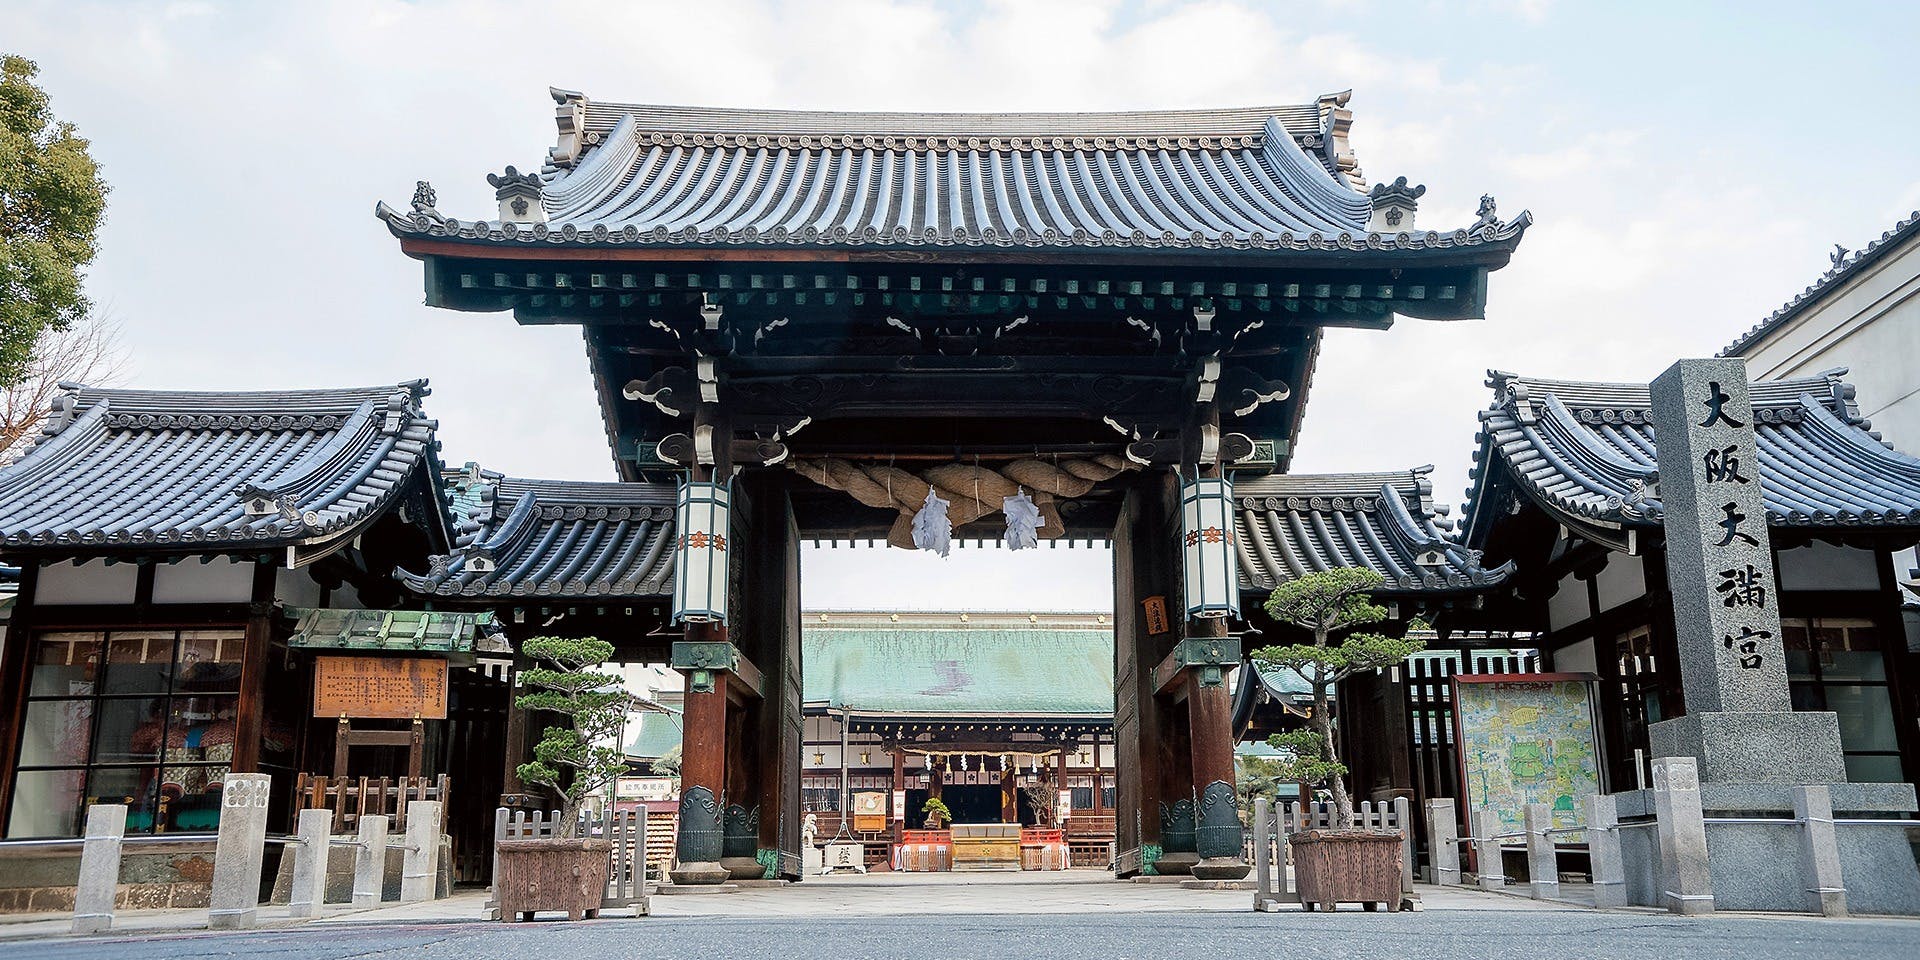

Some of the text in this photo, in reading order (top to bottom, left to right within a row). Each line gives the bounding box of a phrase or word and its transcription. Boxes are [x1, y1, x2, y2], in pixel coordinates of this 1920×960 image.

[1699, 381, 1772, 670] 大阪天満宮
